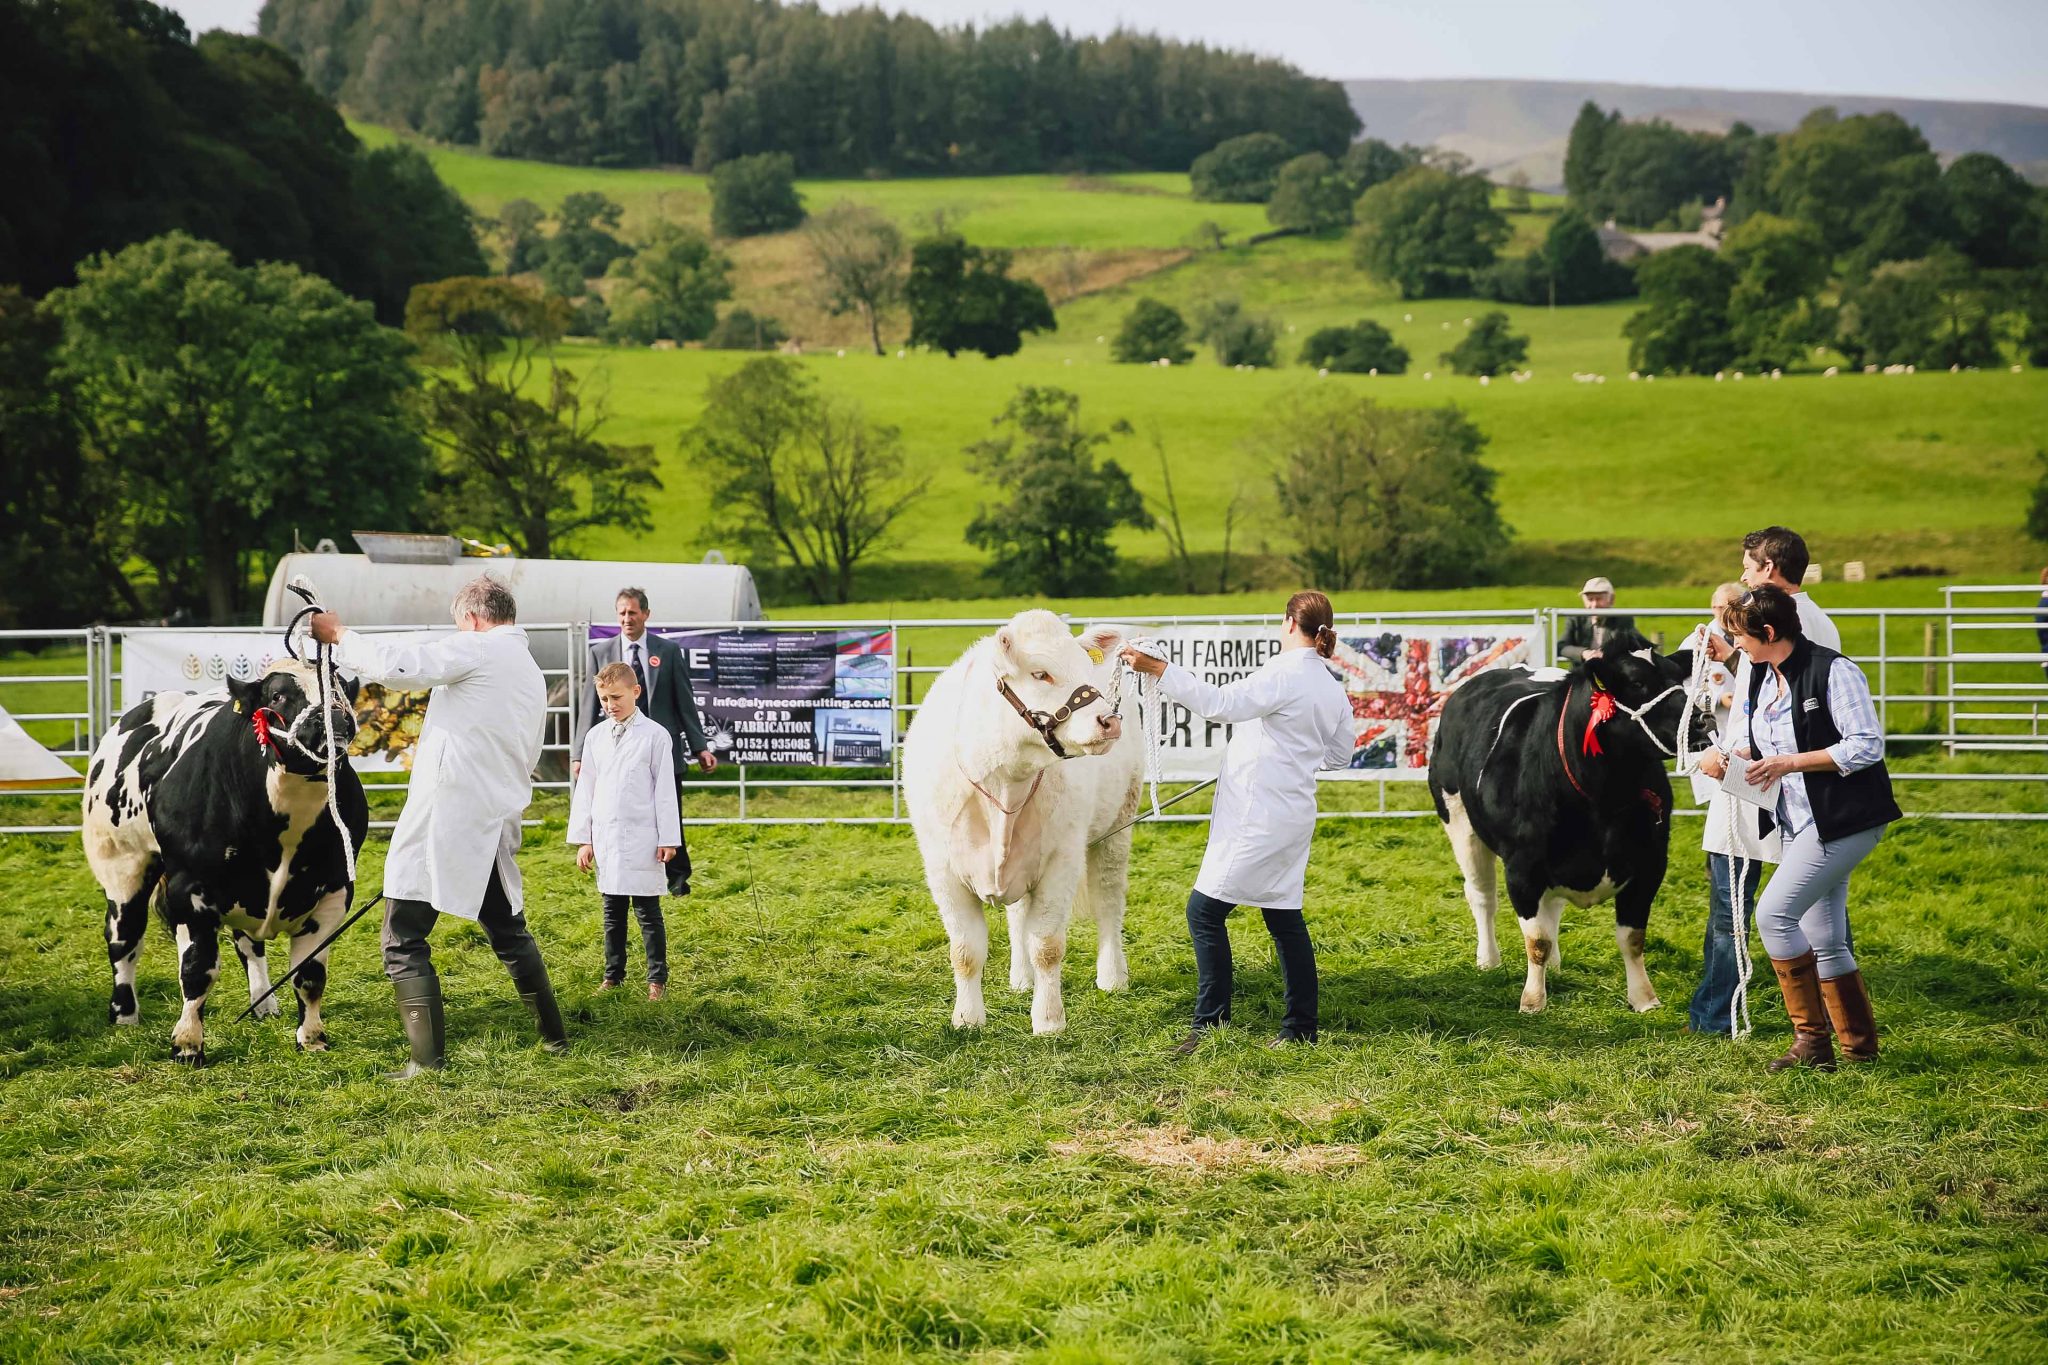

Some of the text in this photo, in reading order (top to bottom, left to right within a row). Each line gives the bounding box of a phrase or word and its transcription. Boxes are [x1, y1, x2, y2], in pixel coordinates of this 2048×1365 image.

[734, 721, 812, 733] FABRICATION
[736, 738, 811, 750] 01524 935085
[729, 751, 815, 762] PLASMA CUTTING
